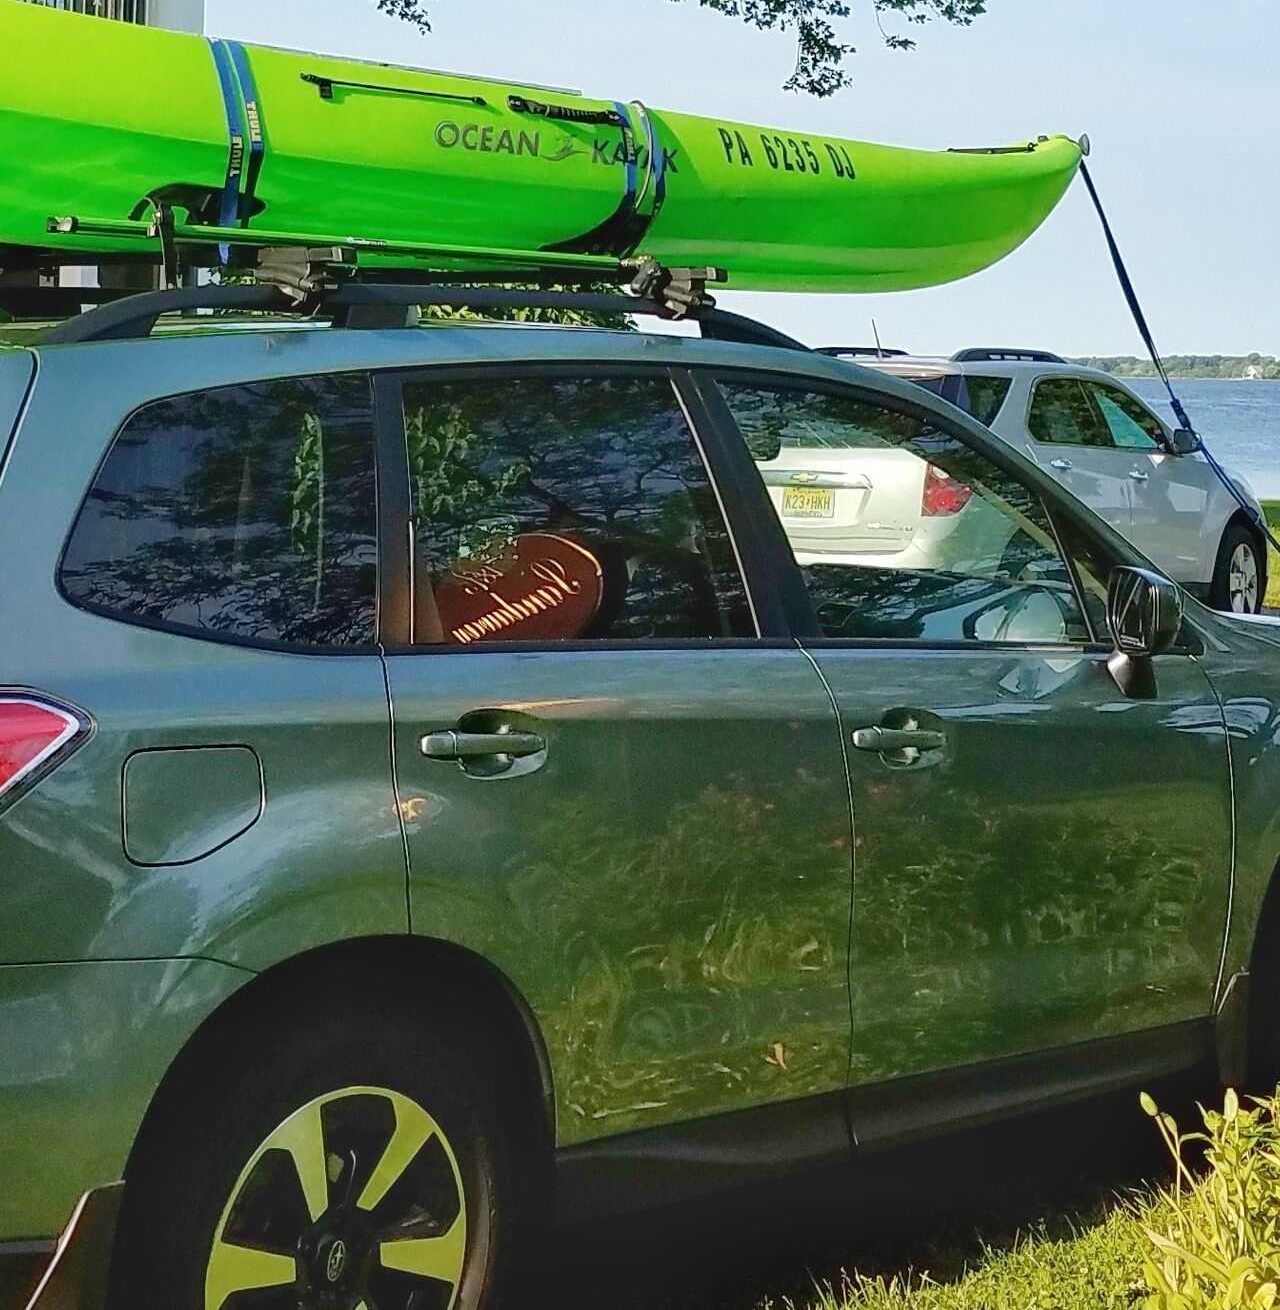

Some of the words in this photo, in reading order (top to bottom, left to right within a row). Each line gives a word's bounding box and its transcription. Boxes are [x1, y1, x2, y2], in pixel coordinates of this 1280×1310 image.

[434, 120, 540, 157] OCEAN
[591, 139, 678, 173] KAYK
[718, 127, 753, 166] PA
[760, 133, 820, 175] 6235
[824, 143, 856, 180] DJ
